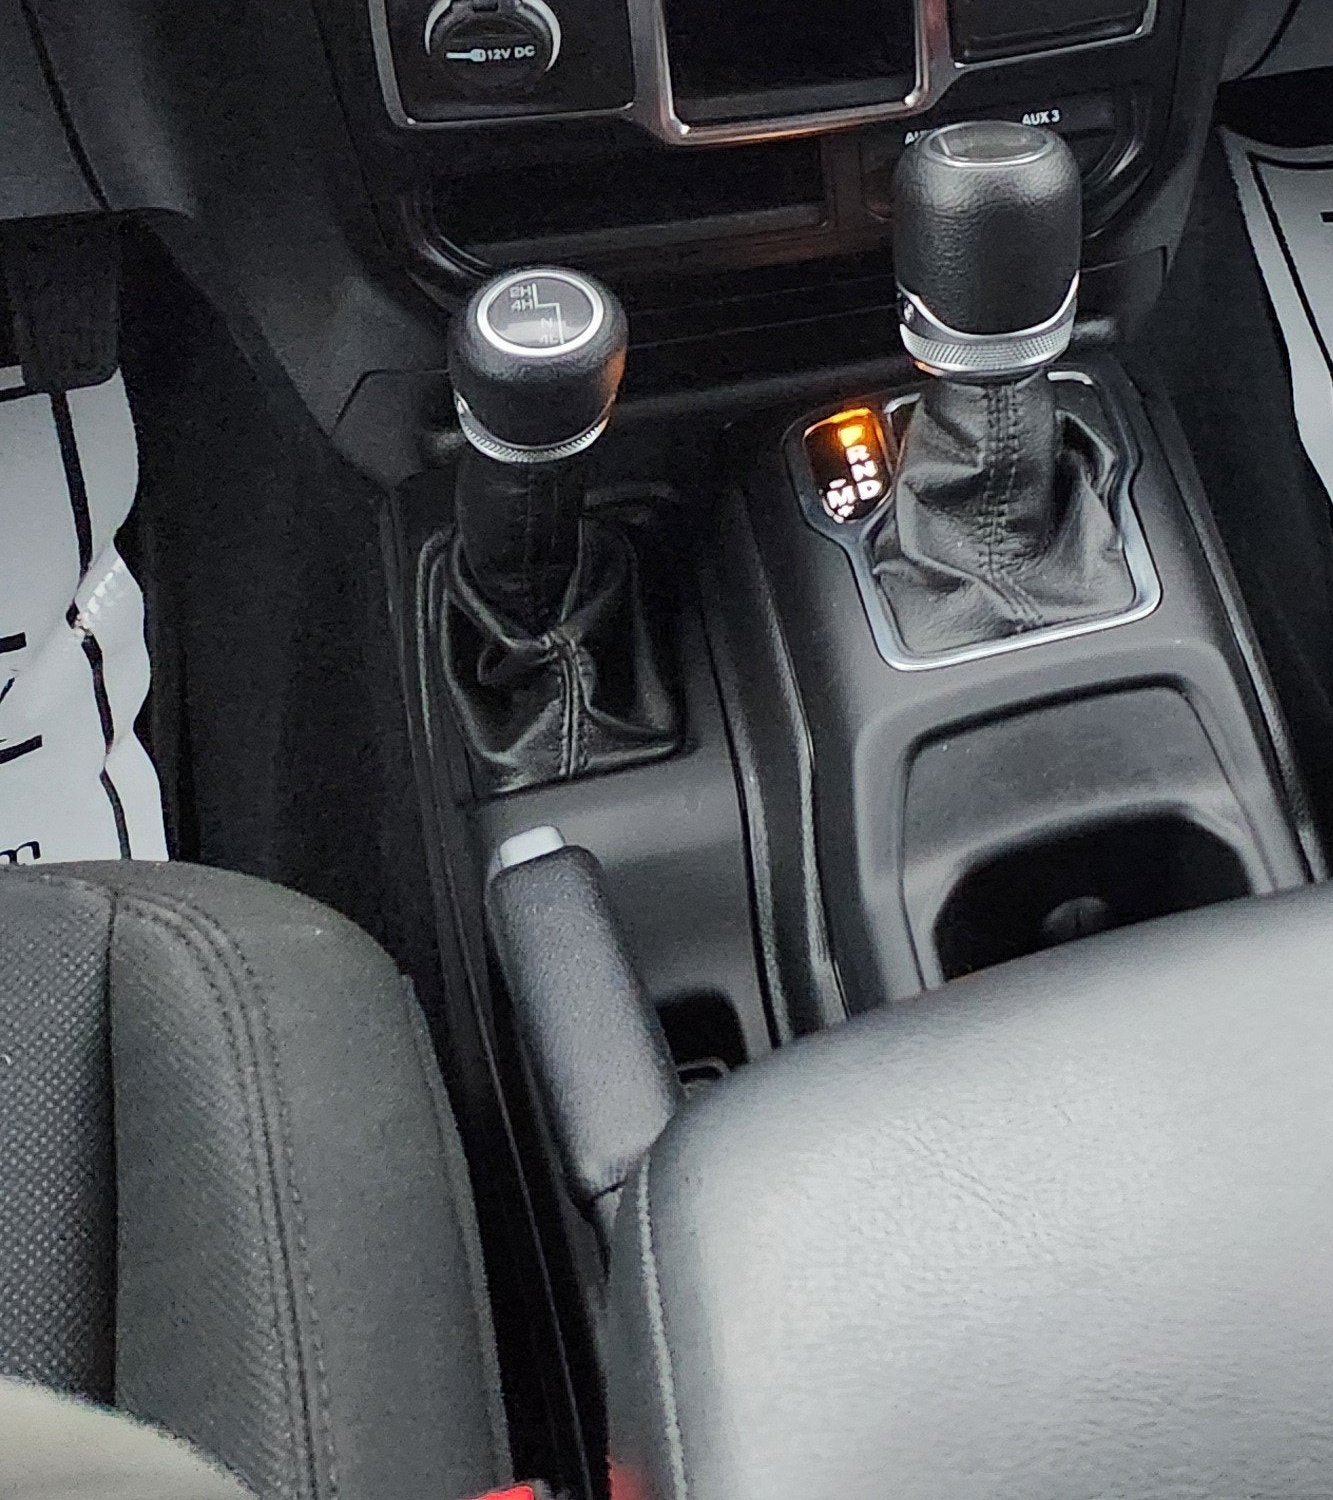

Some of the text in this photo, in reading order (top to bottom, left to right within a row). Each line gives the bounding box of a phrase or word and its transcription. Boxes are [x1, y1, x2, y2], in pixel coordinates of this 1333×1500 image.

[487, 44, 537, 60] 12V DC
[1022, 109, 1060, 125] AUX 3
[511, 298, 534, 311] 4H
[846, 444, 871, 465] R
[851, 460, 879, 482] N
[826, 485, 857, 509] M
[857, 479, 883, 501] D
